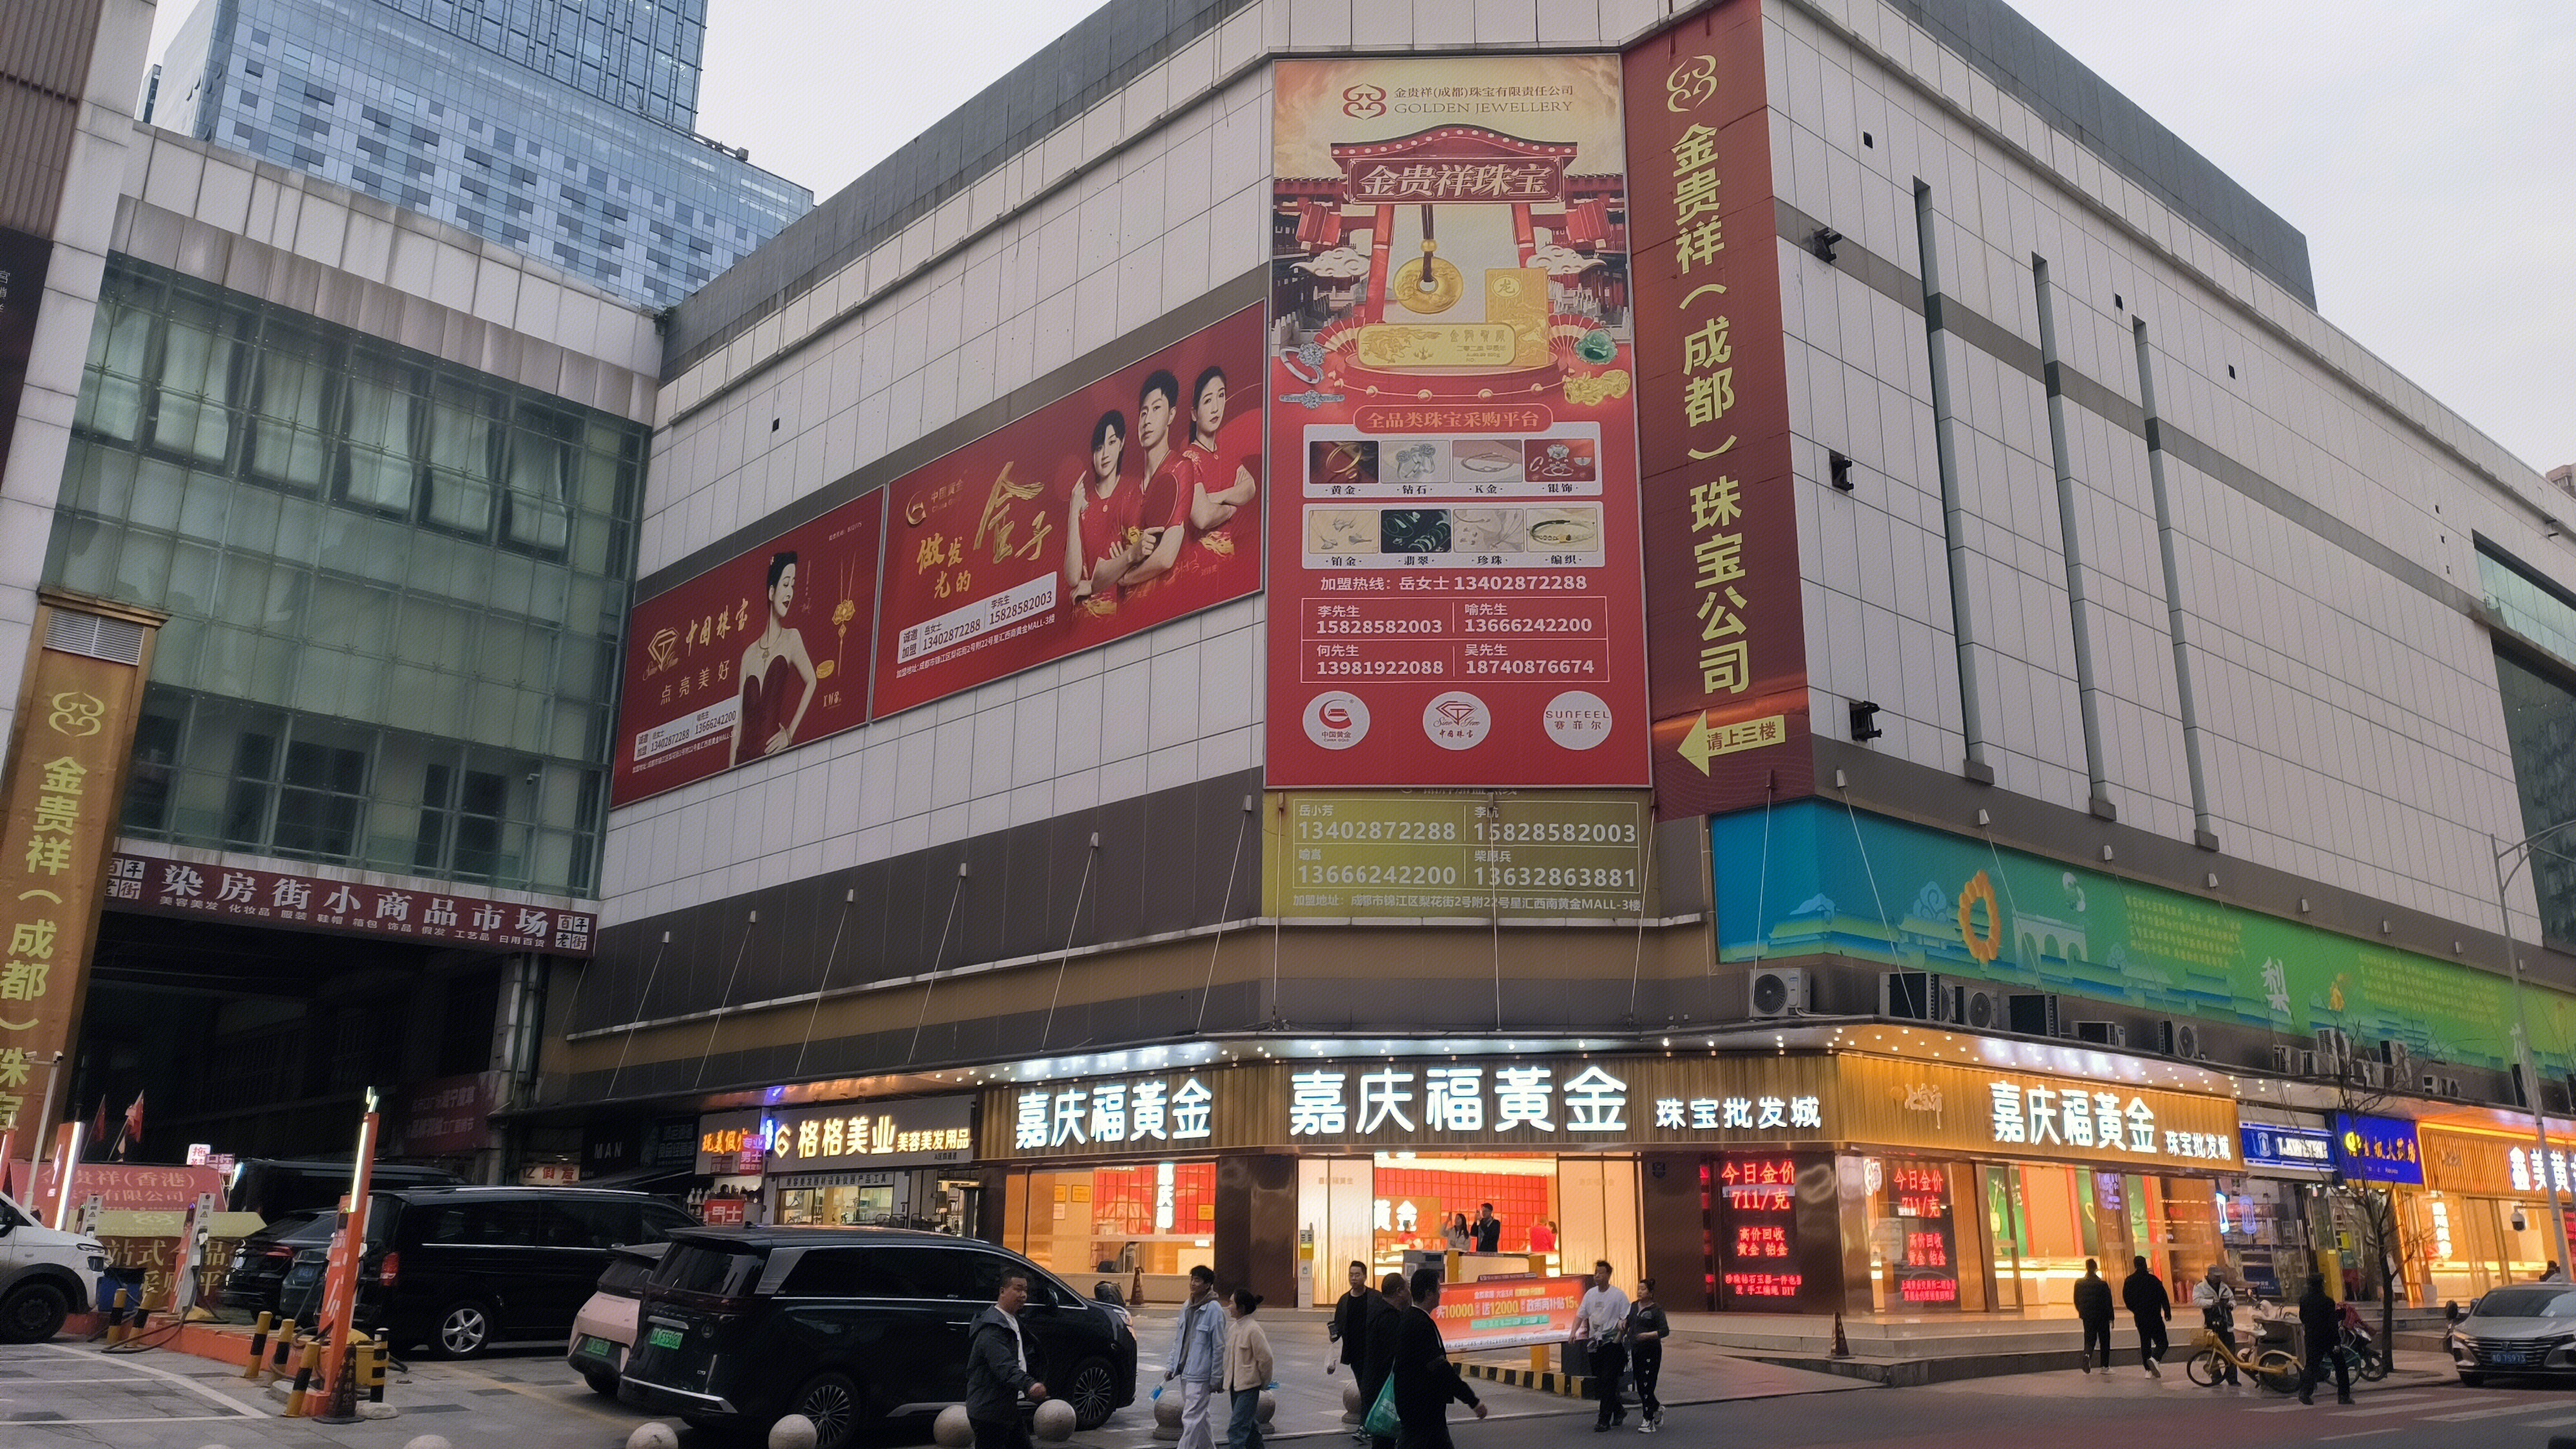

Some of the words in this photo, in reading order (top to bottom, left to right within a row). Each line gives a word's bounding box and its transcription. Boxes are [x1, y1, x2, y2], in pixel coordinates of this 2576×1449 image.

[1394, 85, 1574, 99] 金贵祥(成都)珠宝有限责任公司
[1394, 103, 1470, 114] GOLDEN
[1475, 101, 1574, 114] JEWELLERY
[1362, 163, 1552, 198] 金贵祥珠宝
[1498, 278, 1517, 295] 龙
[1366, 411, 1539, 429] 全品类珠宝采购平台
[932, 479, 963, 503] 中国黄金
[1454, 575, 1587, 591] 13402872288
[989, 591, 1052, 625] 15828582003
[991, 595, 1010, 610] 李先生
[1465, 603, 1508, 616] 喻先生
[1317, 605, 1360, 618] 李先生
[686, 598, 749, 657] 中国珠宝
[924, 621, 943, 636] 岳女士
[1316, 619, 1443, 634] 15828582003
[1464, 618, 1592, 632] 13666242200
[923, 619, 981, 650] 13402872288
[902, 643, 917, 659] 加盟
[1317, 644, 1359, 657] 何先生
[1465, 643, 1508, 656] 吴先生
[1317, 661, 1444, 675] 13981922088
[1466, 659, 1594, 674] 18740876674
[660, 660, 730, 706] 点亮美好
[695, 710, 737, 735] 13666242200
[1546, 710, 1609, 719] SUNFEEL
[1439, 728, 1474, 738] 中国珠宝
[1554, 721, 1602, 730] 赛菲尔
[650, 728, 690, 752] 13402872288
[1321, 730, 1352, 739] 中国黄金
[1707, 721, 1777, 752] 请上三楼
[1299, 804, 1334, 817] 岳小芳
[1299, 821, 1457, 841] 13402872288
[1474, 823, 1635, 842] 15828582003
[1299, 865, 1457, 885] 13666242200
[1474, 867, 1635, 888] 13632863881
[162, 864, 549, 939] 染房街小商品市场
[159, 896, 219, 911] 美容美发
[230, 904, 271, 917] 化妆品
[280, 910, 308, 923] 服装
[317, 913, 343, 926] 鞋帽
[353, 917, 378, 930] 箱包
[387, 921, 412, 934] 饰品
[421, 925, 446, 937] 假发
[454, 929, 490, 942] 工艺品
[499, 934, 546, 948] 日用百货
[557, 914, 589, 934] 百年
[555, 932, 588, 950] 老街
[1656, 1096, 1821, 1131] 珠宝批发城
[743, 1137, 763, 1149] 专业
[797, 1115, 897, 1159] 格格美业
[897, 1127, 970, 1152] 美容美发用品
[2165, 1130, 2232, 1161] 珠宝批发城
[594, 1142, 623, 1159] MAN
[741, 1151, 762, 1163] 男士
[1722, 1160, 1796, 1185] 今日金价
[1893, 1167, 1944, 1193] 今日金价
[1731, 1187, 1790, 1211] 711/克
[1901, 1195, 1941, 1219] 711/克
[1739, 1227, 1785, 1242] 高价回收
[1909, 1233, 1943, 1248] 高价回收
[1737, 1242, 1760, 1257] 黄金
[1765, 1242, 1789, 1257] 铂金
[1908, 1249, 1926, 1267] 黄金
[1781, 1286, 1795, 1296] DIY
